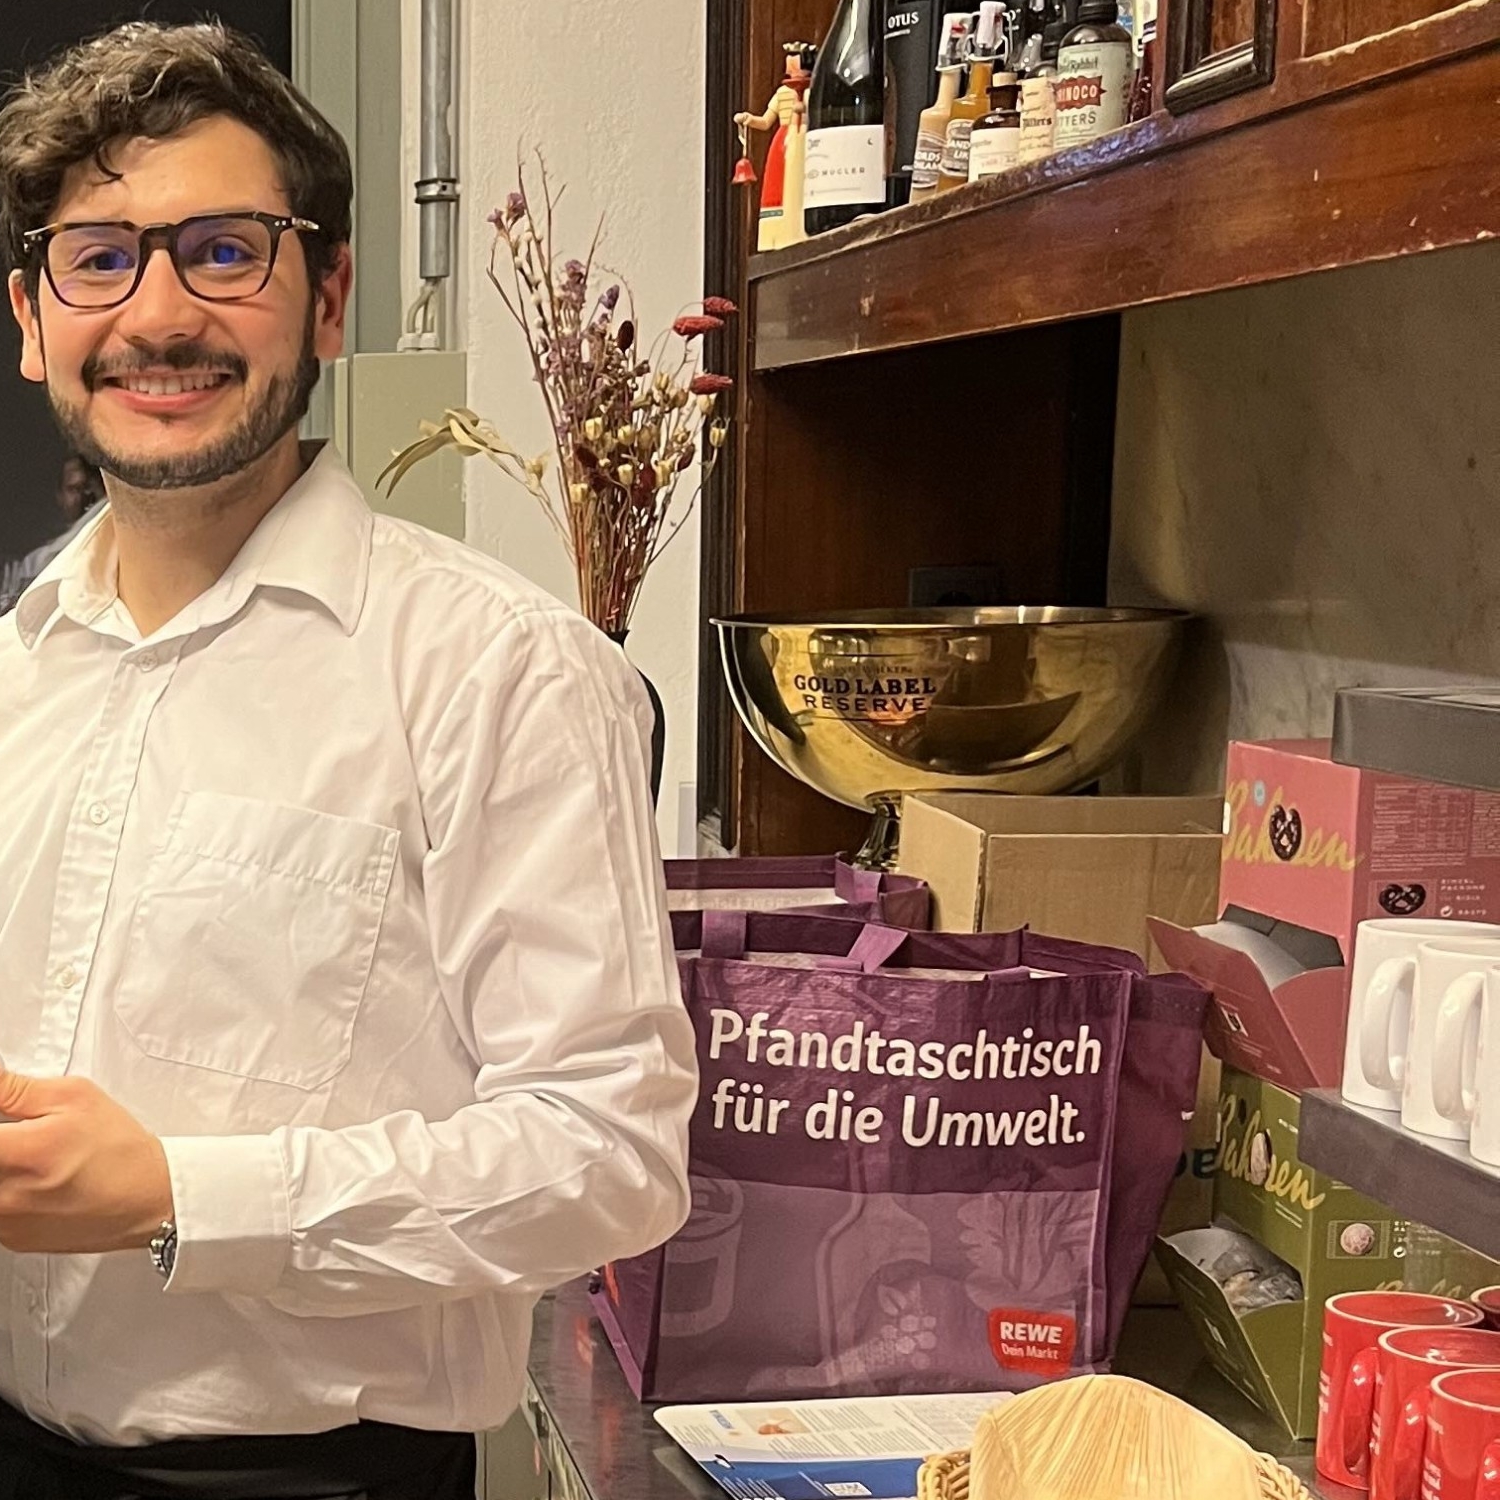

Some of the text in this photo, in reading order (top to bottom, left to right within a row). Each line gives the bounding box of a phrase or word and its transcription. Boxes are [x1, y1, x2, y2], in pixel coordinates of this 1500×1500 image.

[887, 12, 919, 29] OTUS
[1056, 85, 1098, 102] RINOCO
[1059, 111, 1097, 126] TTERS
[794, 674, 936, 695] GOLD LABEL
[803, 694, 927, 712] RESERVE
[709, 1008, 1101, 1080] Pfandtaschtisch
[712, 1079, 1086, 1147] für die Umwelt.
[1000, 1321, 1062, 1344] REWE
[1001, 1342, 1058, 1360] Dein Markt
